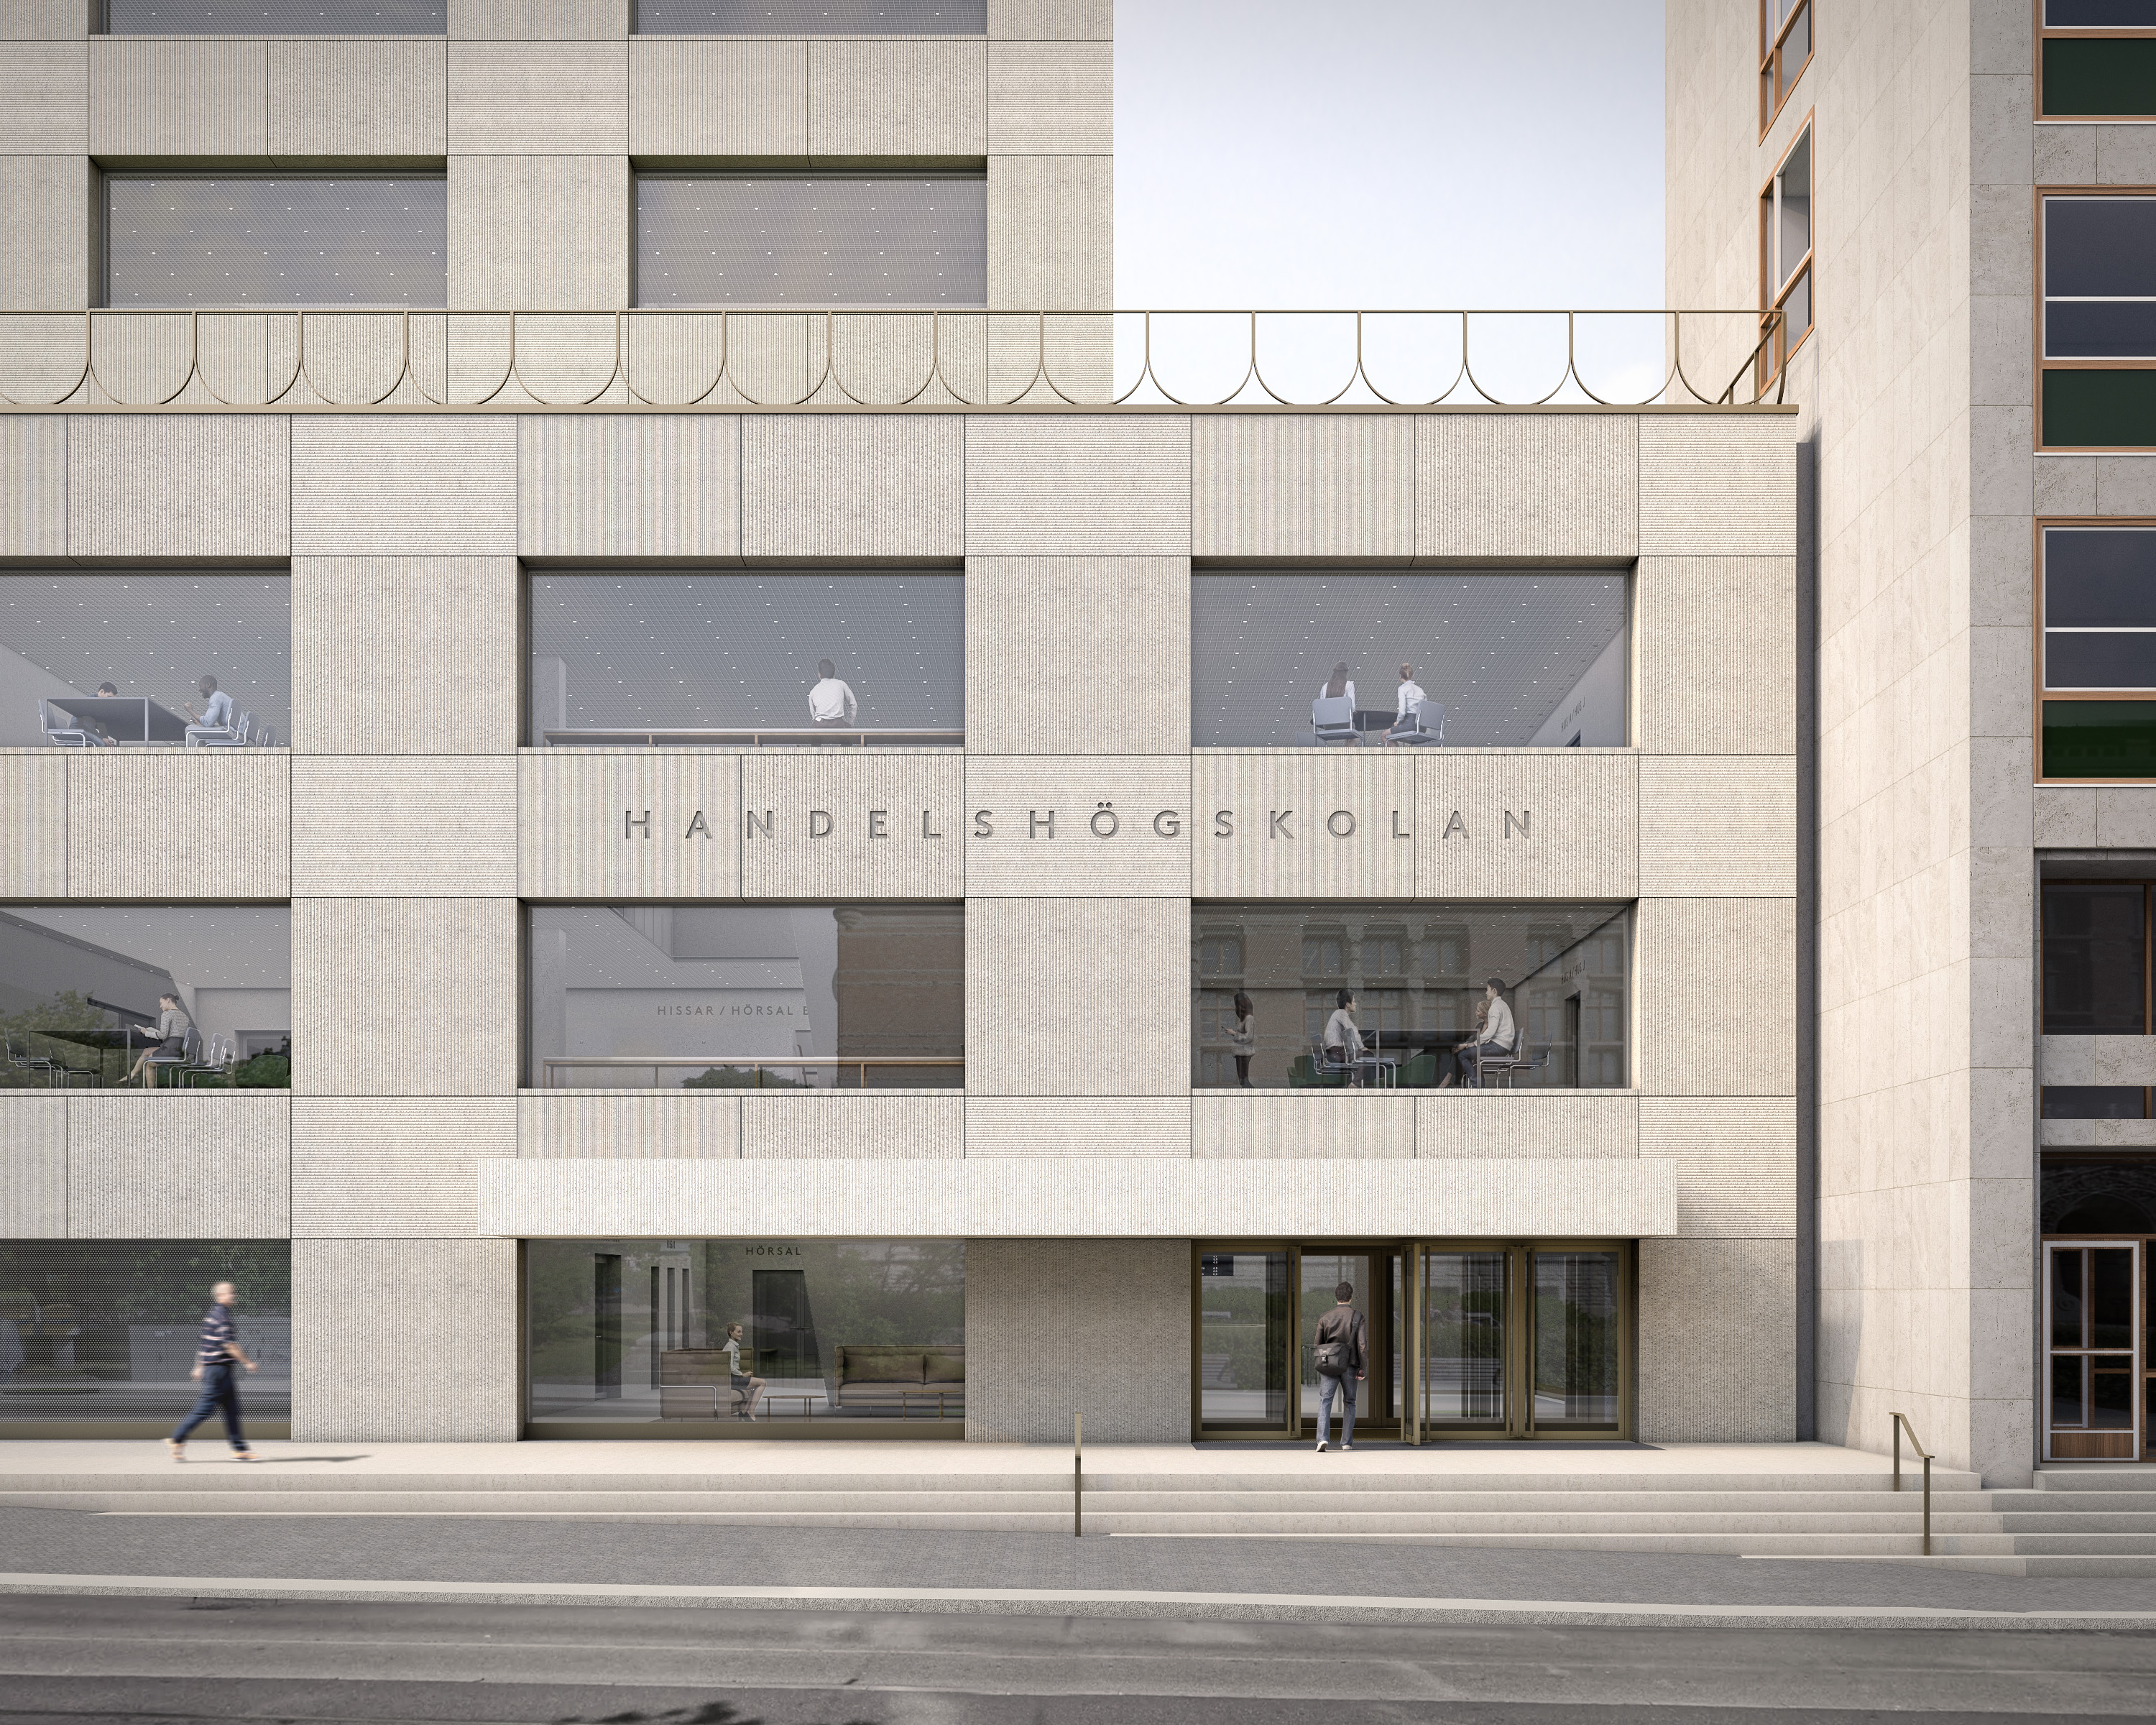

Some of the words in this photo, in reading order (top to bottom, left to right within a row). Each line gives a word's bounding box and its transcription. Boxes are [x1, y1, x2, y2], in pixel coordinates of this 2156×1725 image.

[625, 801, 1531, 840] HANDELSHÖGSKOLAN
[658, 1006, 714, 1016] HISSAR
[719, 1006, 726, 1016] /
[732, 1004, 793, 1016] HÖRSAL
[745, 1245, 801, 1256] HÖRSAL
